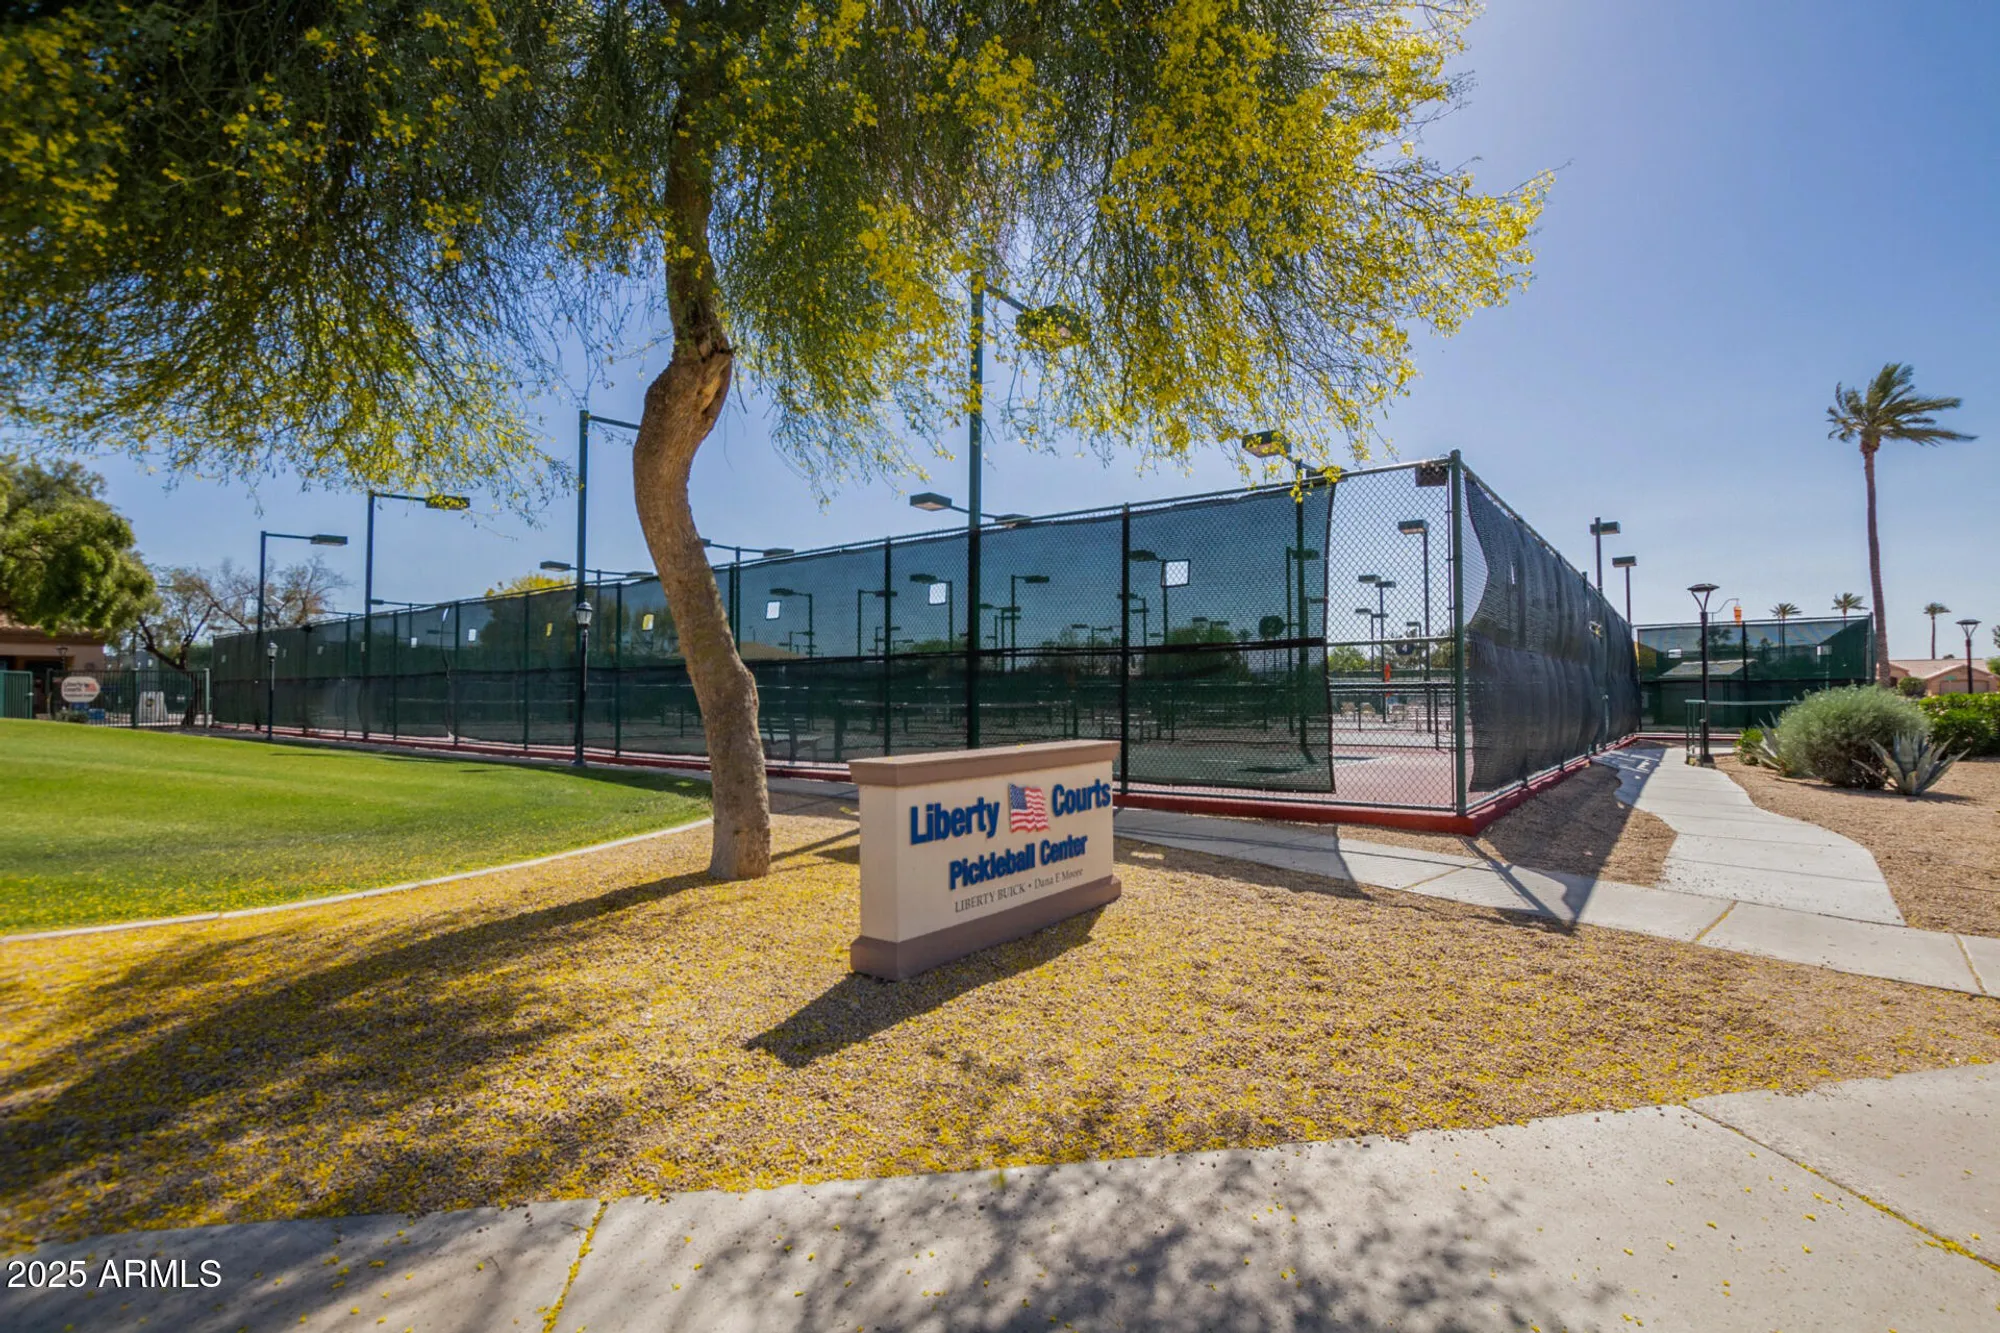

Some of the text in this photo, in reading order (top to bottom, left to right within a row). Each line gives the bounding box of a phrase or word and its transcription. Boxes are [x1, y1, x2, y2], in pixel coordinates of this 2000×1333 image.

[910, 778, 1112, 845] Liberty Courts
[949, 834, 1088, 890] Pickleball Center
[954, 890, 995, 913] LIBERTY
[997, 882, 1026, 901] BUICK
[1034, 877, 1054, 889] Dana
